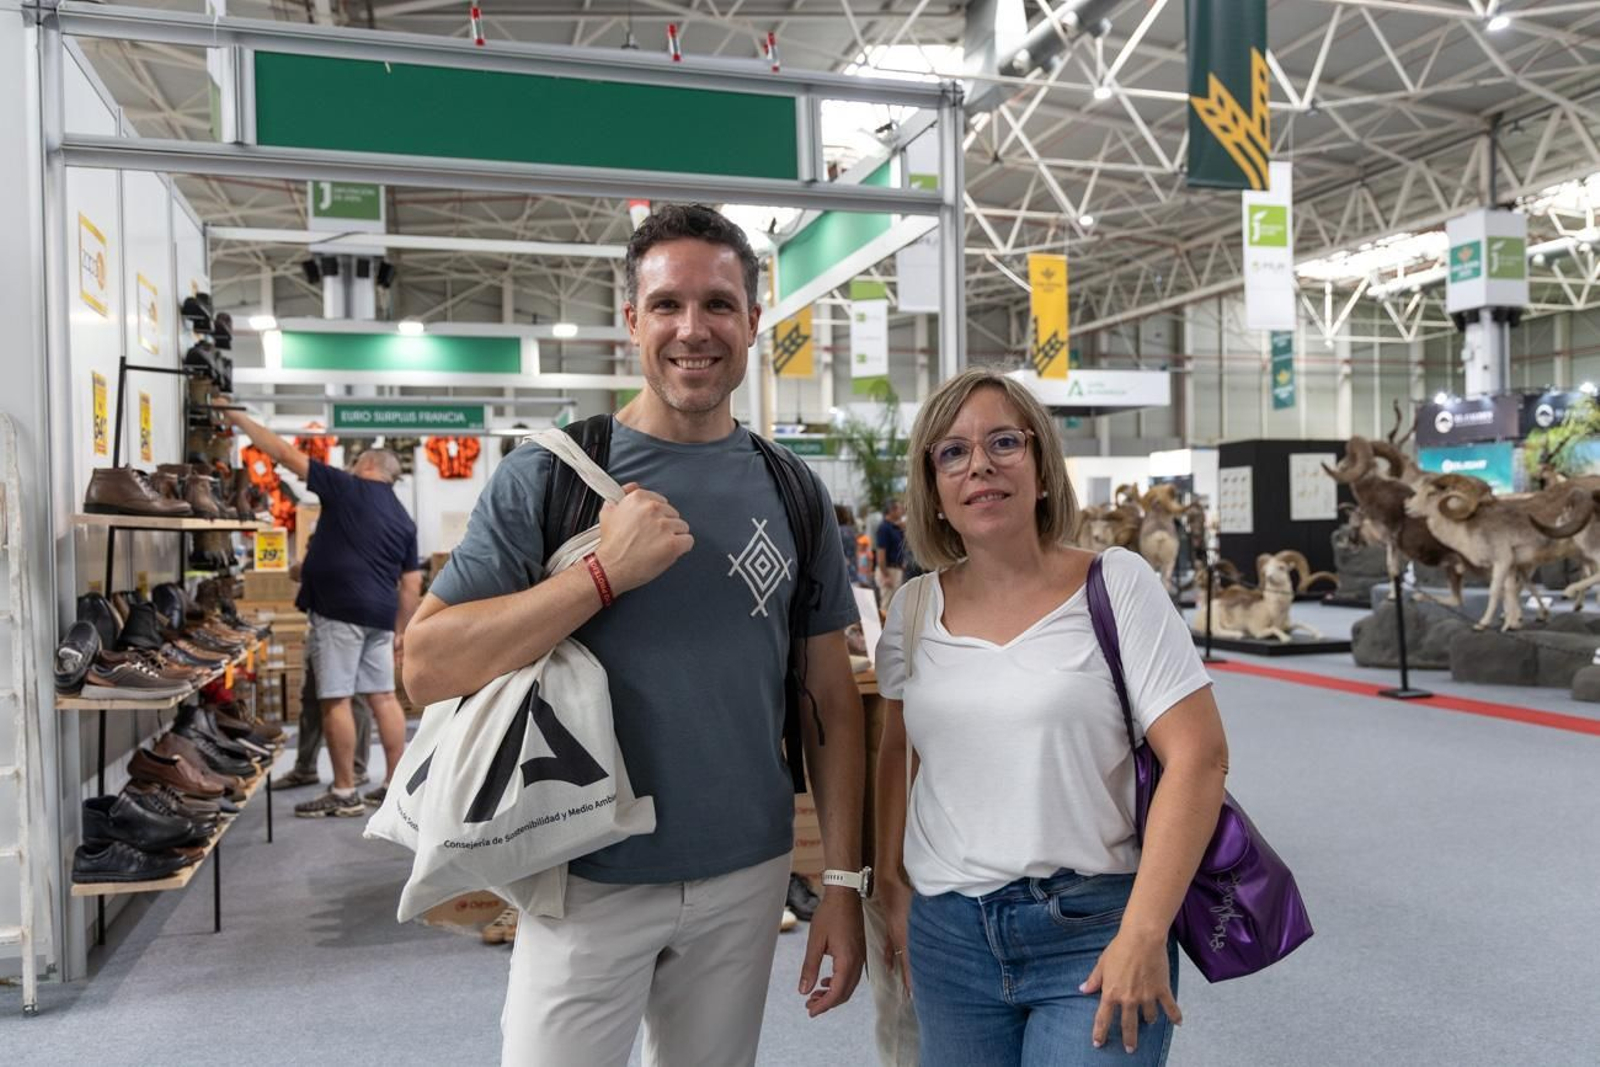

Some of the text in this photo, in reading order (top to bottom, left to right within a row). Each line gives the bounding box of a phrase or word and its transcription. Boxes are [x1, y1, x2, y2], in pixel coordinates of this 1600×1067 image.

[341, 411, 466, 423] EURO SURPLUS FRANCIA
[443, 838, 491, 850] Consejería
[492, 837, 504, 846] de
[504, 812, 561, 843] Sostenibilidad
[562, 811, 568, 822] y
[568, 803, 595, 818] Medio
